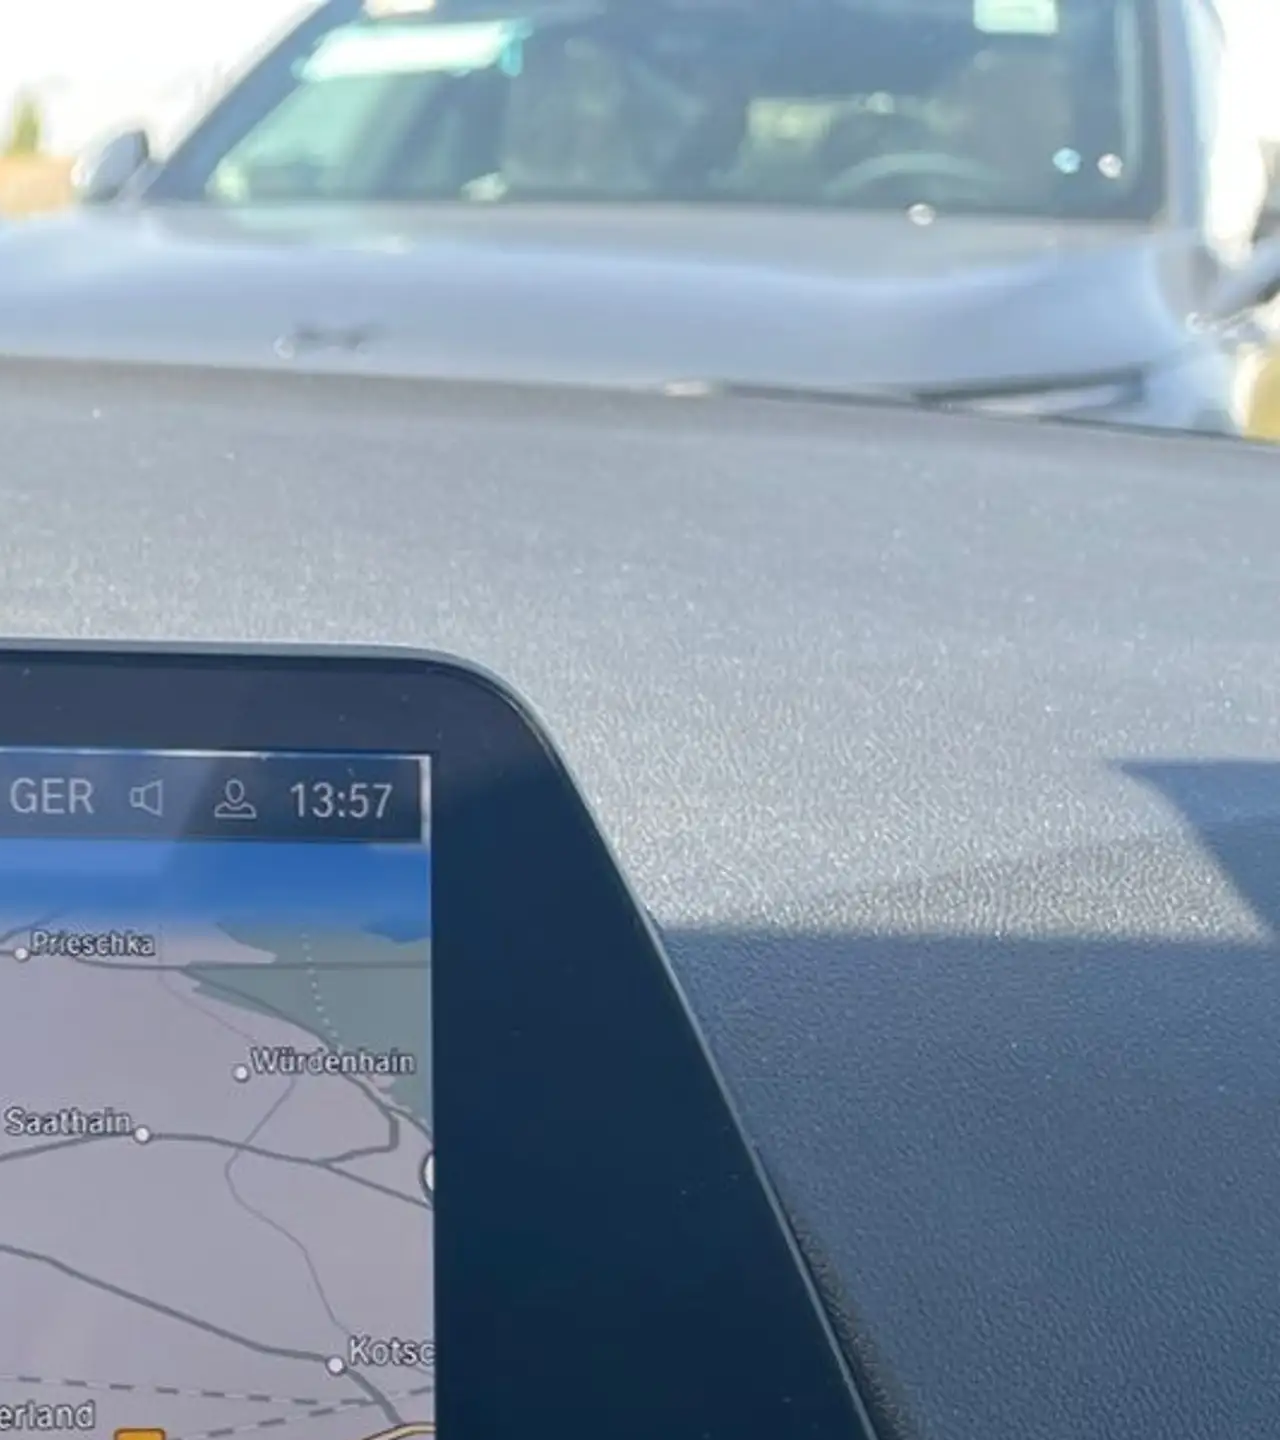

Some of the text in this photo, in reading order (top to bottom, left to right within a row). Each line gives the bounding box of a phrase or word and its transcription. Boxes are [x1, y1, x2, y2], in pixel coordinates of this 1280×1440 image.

[10, 777, 95, 815] GER
[290, 782, 393, 819] 13:57
[30, 931, 155, 957] Prieschka
[251, 1047, 415, 1075] Würdenhain
[4, 1107, 132, 1136] Saathain
